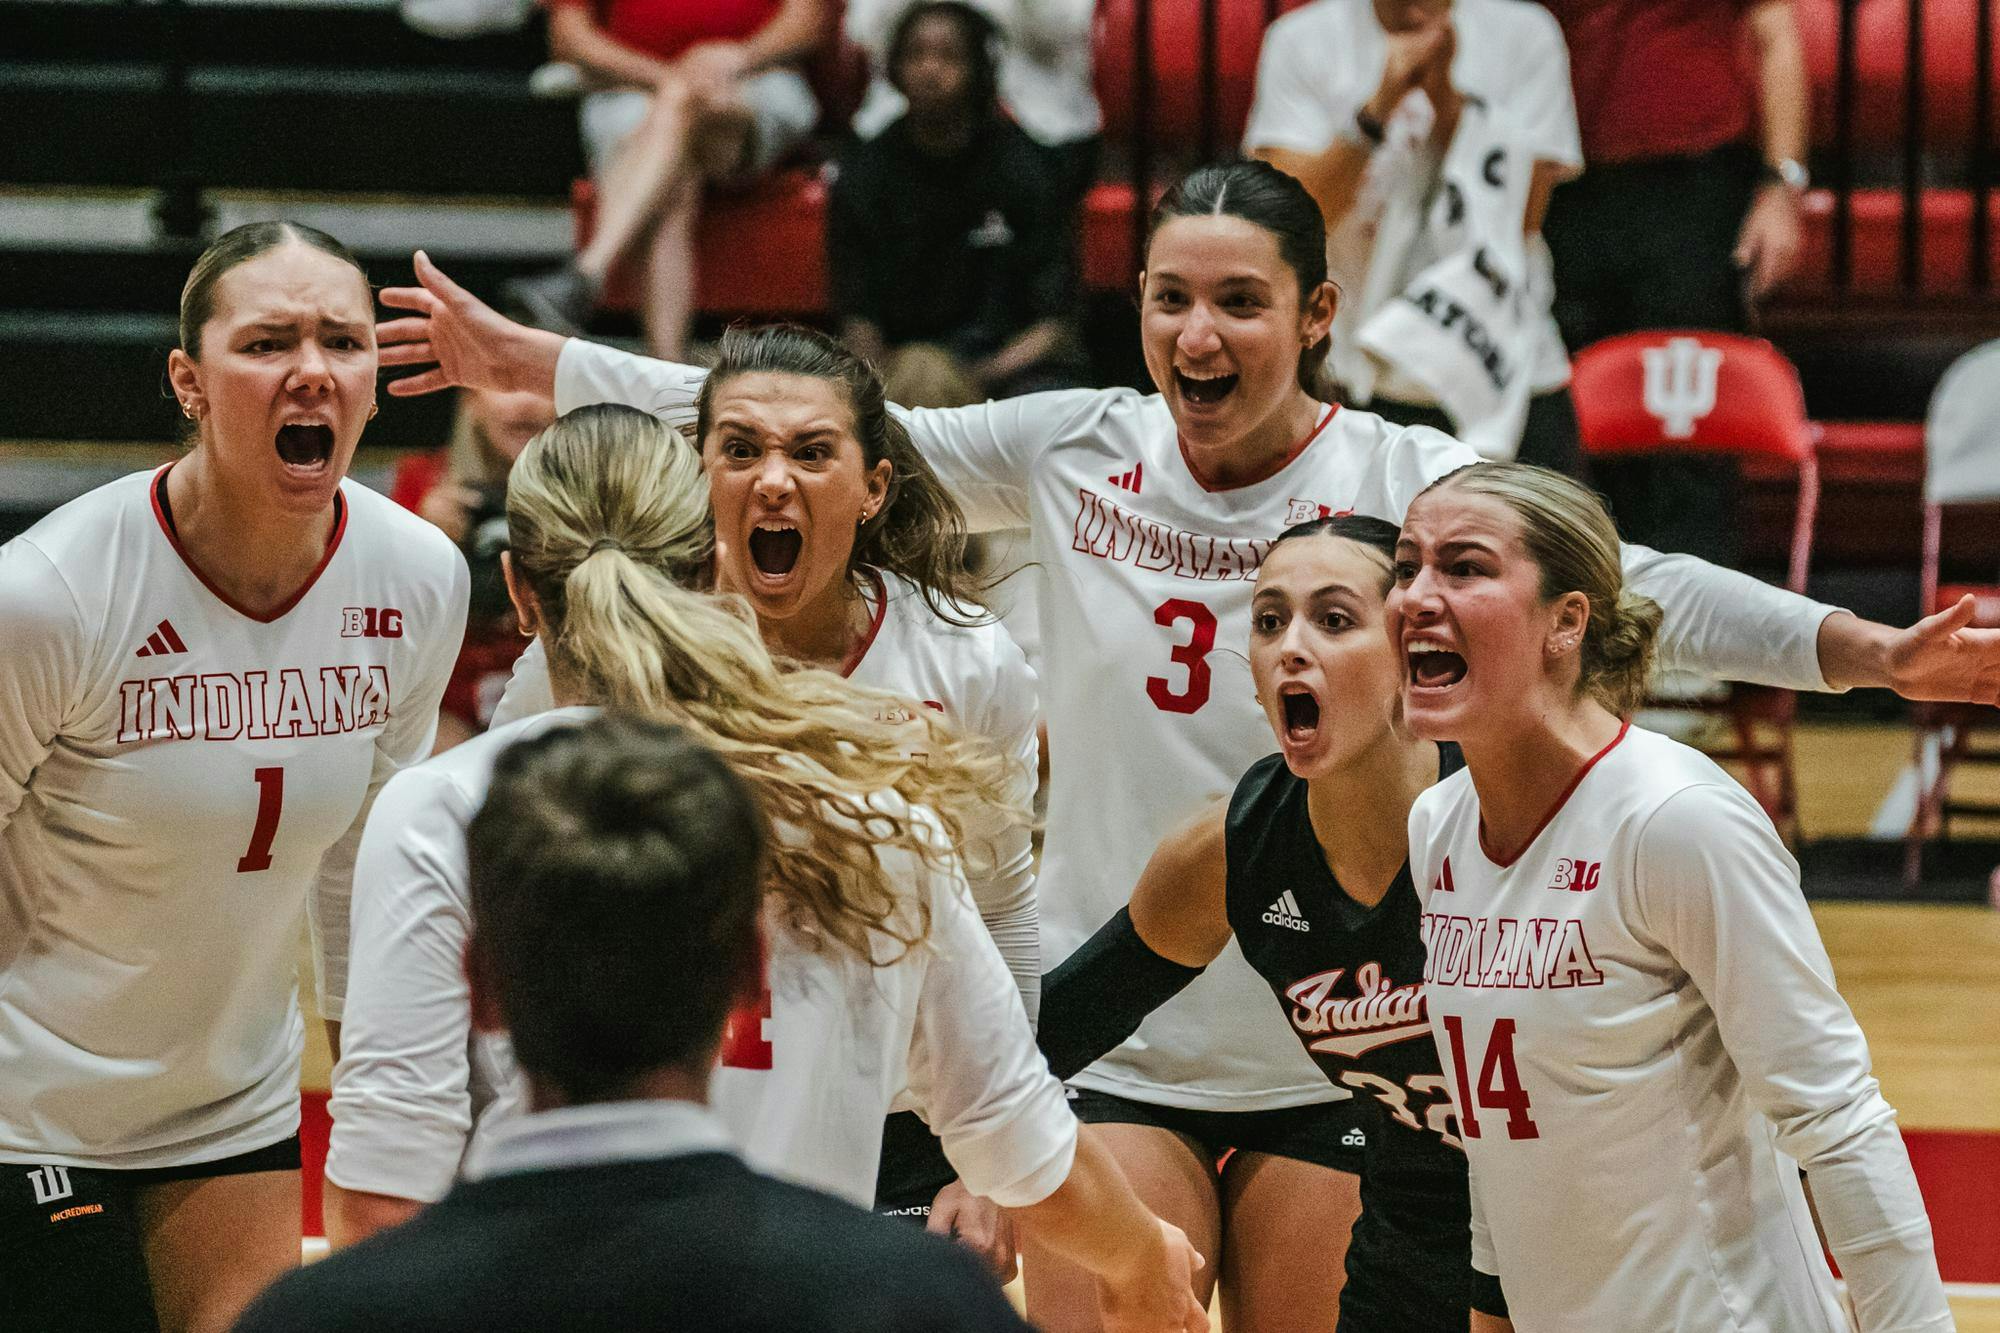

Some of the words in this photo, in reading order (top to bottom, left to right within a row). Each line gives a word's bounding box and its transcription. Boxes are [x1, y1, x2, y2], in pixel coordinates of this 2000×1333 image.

[1146, 598, 1217, 714] 3
[117, 666, 390, 744] INDIANA
[237, 767, 284, 873] 1
[1262, 911, 1310, 932] adidas
[1421, 913, 1604, 989] NDIANA
[1340, 1069, 1464, 1151] 32
[1443, 1015, 1540, 1140] 14
[50, 1203, 104, 1223] INCREDIWEAR
